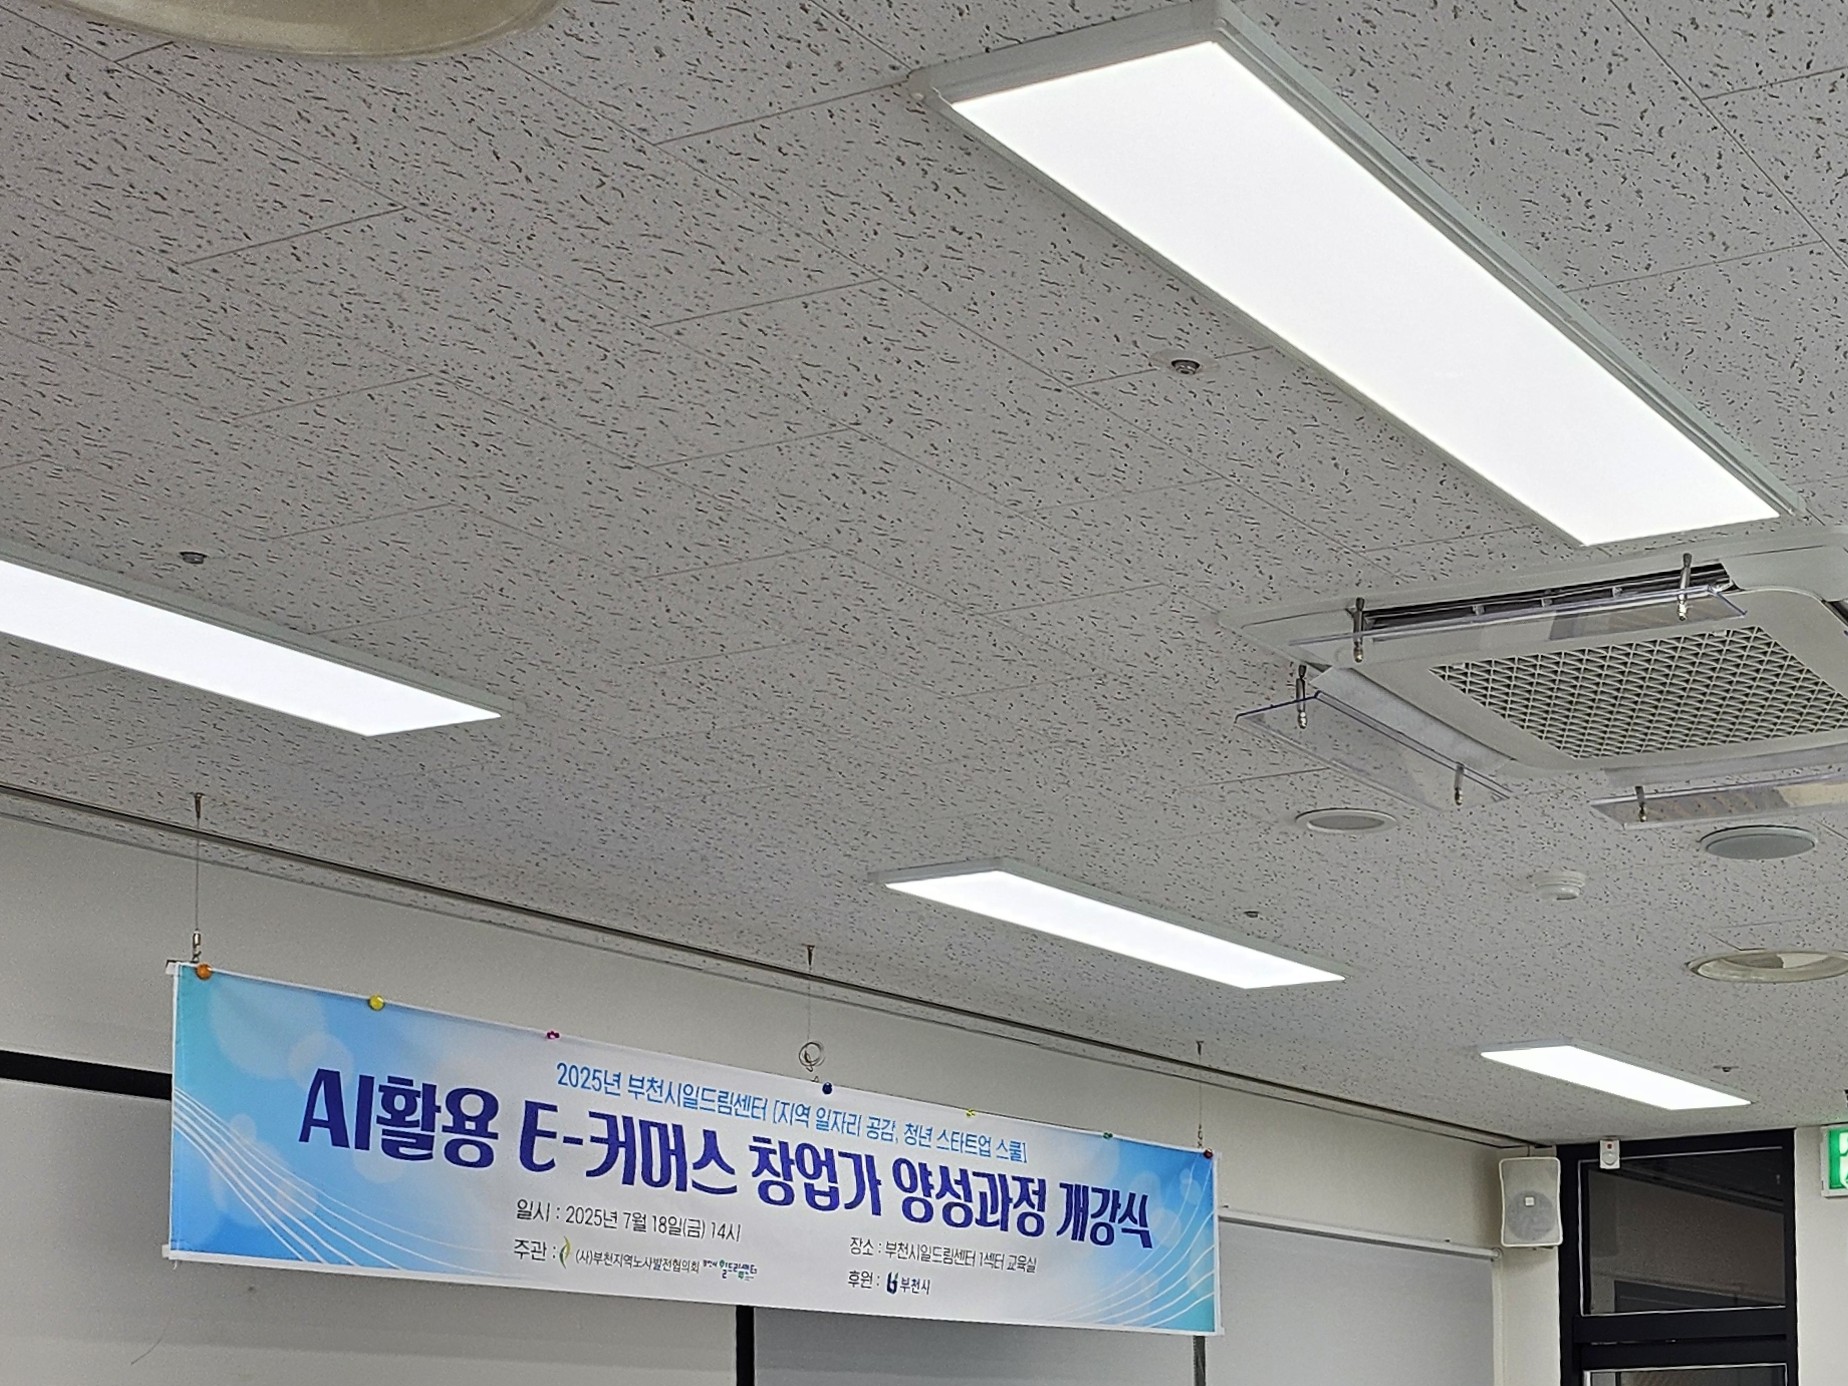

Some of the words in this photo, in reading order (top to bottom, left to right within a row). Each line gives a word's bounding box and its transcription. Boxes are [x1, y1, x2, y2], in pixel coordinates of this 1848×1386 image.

[556, 1062, 622, 1097] 2025년
[628, 1074, 768, 1122] 부천시일드림센터
[773, 1099, 812, 1128] [지역
[815, 1105, 863, 1137] 일자리
[866, 1116, 899, 1144] 공감,
[903, 1122, 935, 1148] 청년
[937, 1129, 992, 1157] 스타트업
[996, 1139, 1028, 1163] 스쿨]
[298, 1067, 501, 1170] AI활용
[518, 1099, 738, 1196] E-커머스
[749, 1135, 883, 1217] 창업가
[891, 1157, 1047, 1239] 양성과정
[1056, 1181, 1154, 1249] 개강식
[516, 1198, 551, 1222] 일시
[565, 1205, 619, 1230] 2025년
[623, 1211, 647, 1233] 7월
[652, 1214, 706, 1240] 18일(금)
[711, 1221, 742, 1243] 14시
[513, 1238, 548, 1262] 주관
[849, 1236, 874, 1256] 장소
[885, 1240, 976, 1267] 부천시일드림센터
[1006, 1254, 1039, 1274] 교육실
[848, 1269, 874, 1290] 후원
[900, 1277, 931, 1295] 부천시
